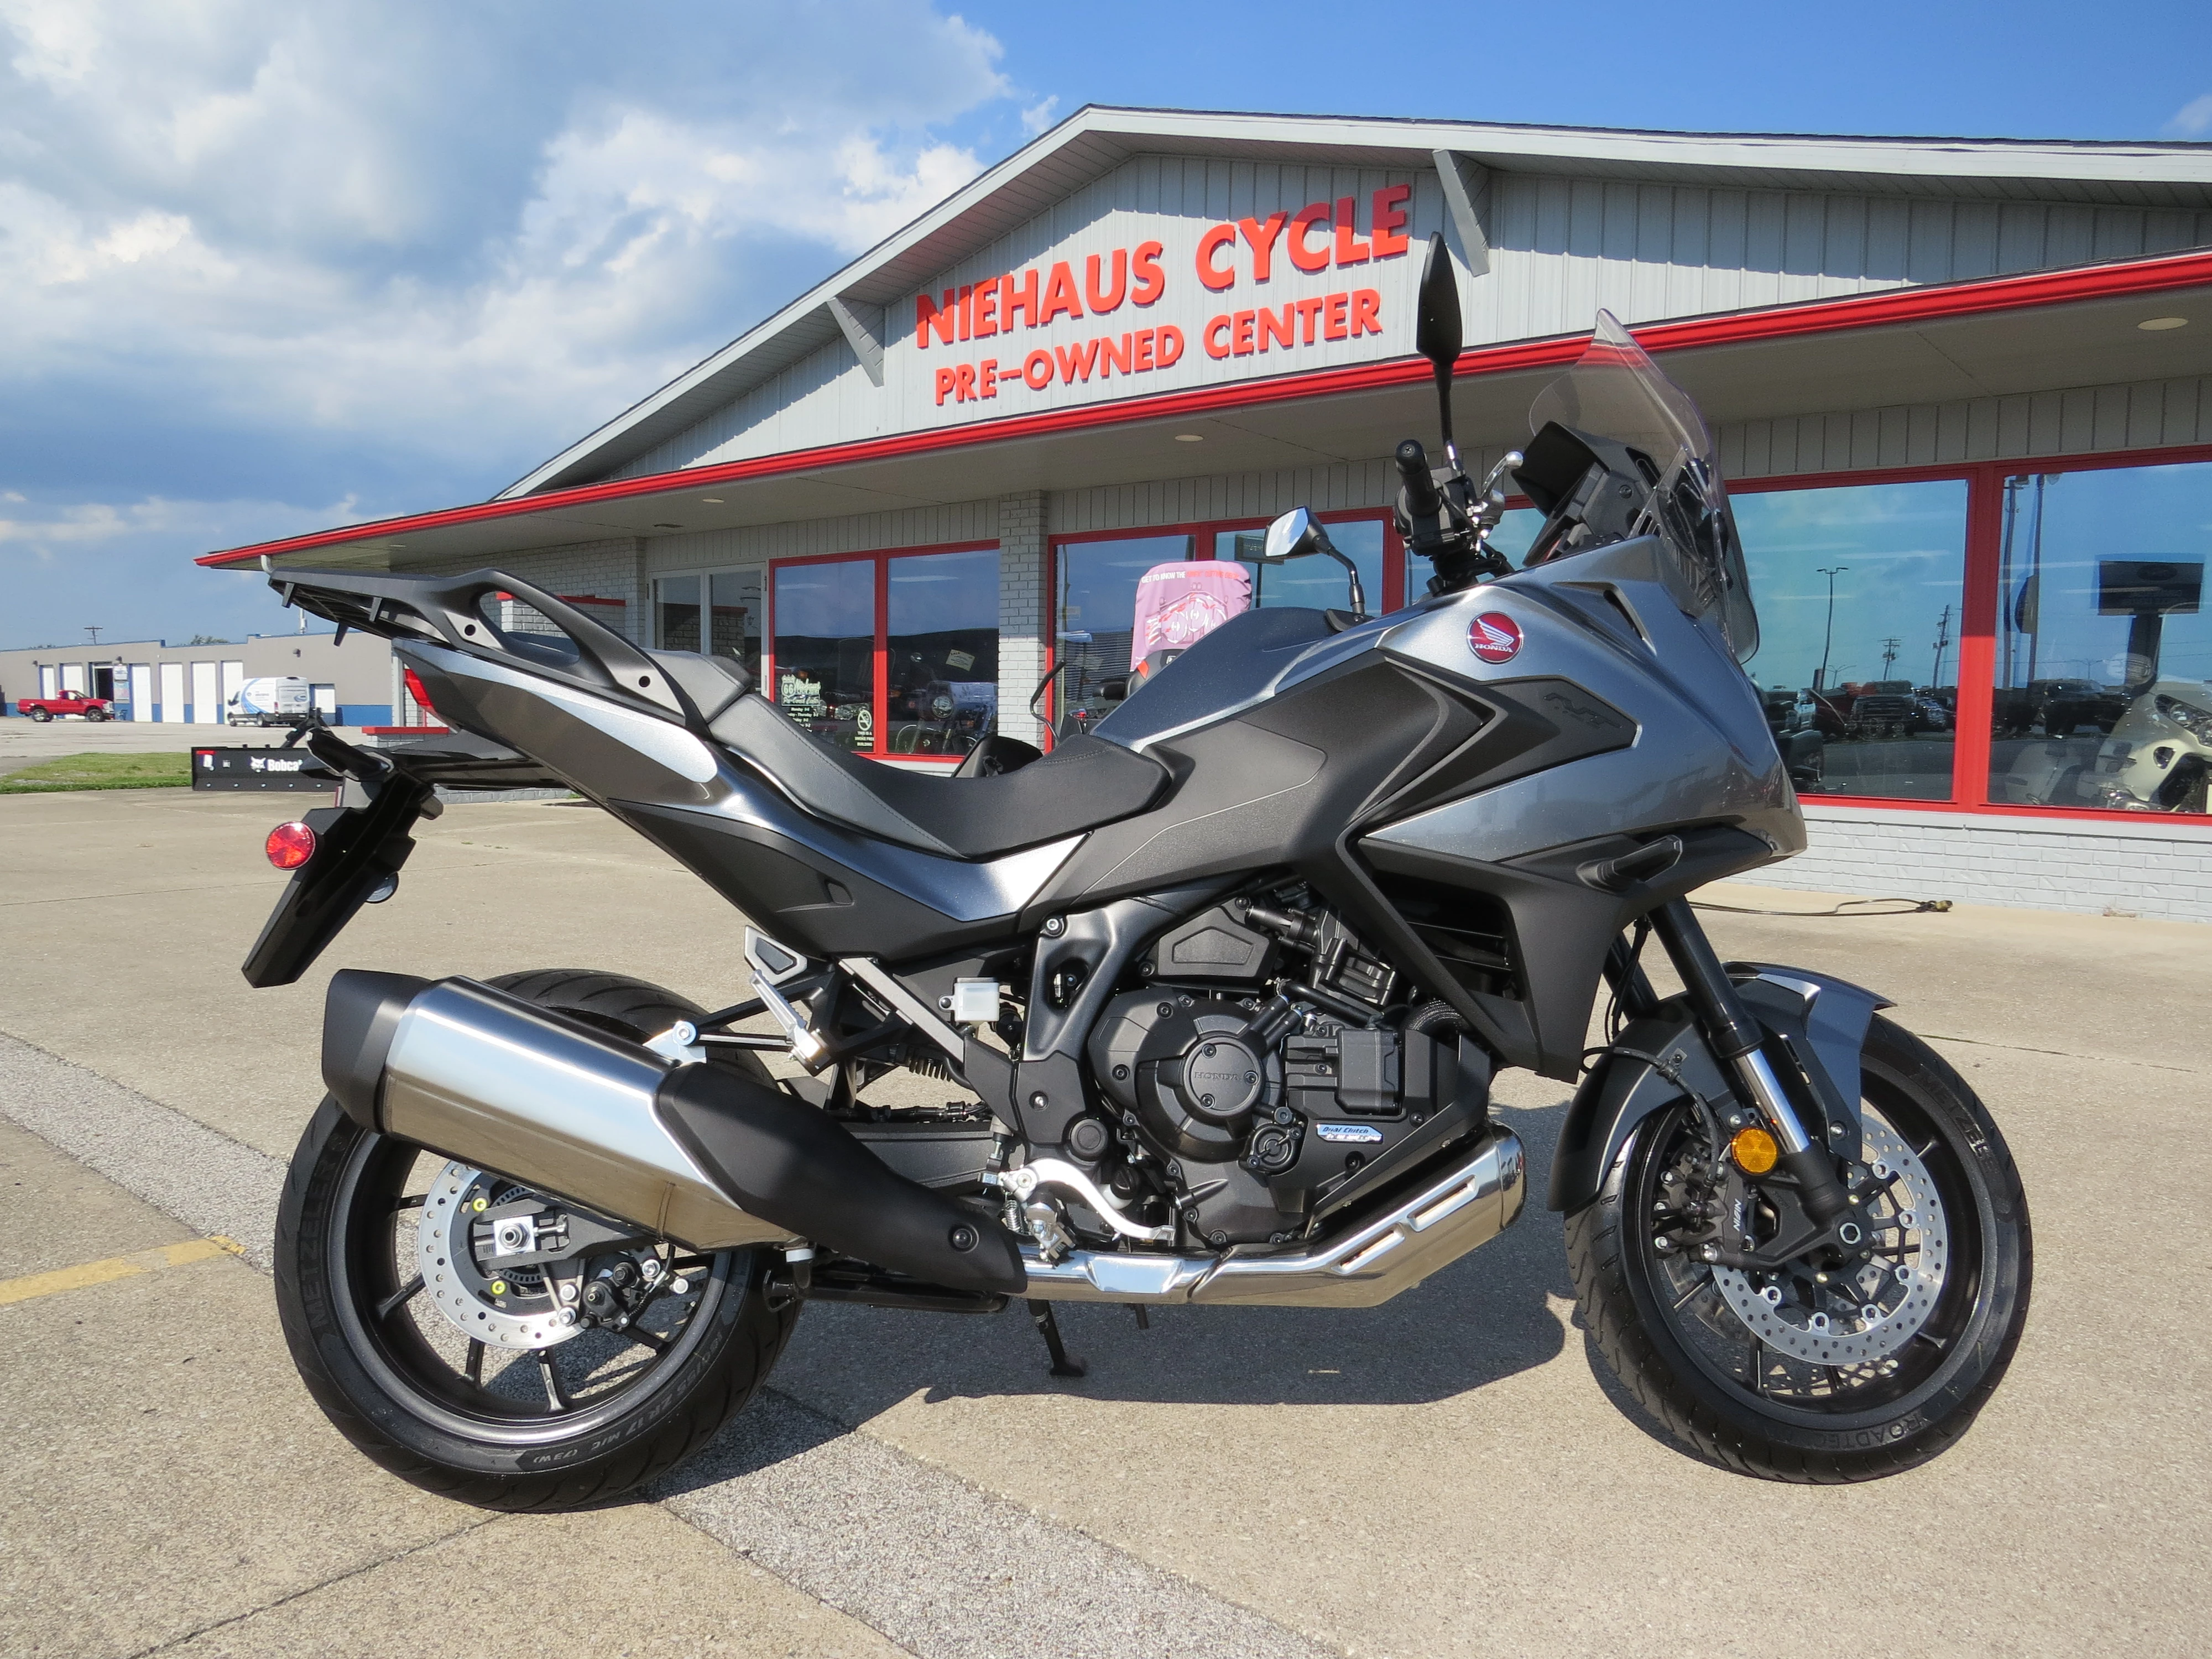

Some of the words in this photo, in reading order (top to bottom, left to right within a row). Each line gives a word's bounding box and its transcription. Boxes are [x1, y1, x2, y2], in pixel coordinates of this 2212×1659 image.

[916, 241, 1165, 348] NIEHAUS
[1196, 184, 1411, 290] CYCLE
[935, 324, 1184, 405] PRE-OWNED
[1203, 288, 1383, 359] CENTER
[1141, 576, 1152, 584] GET
[1160, 571, 1176, 581] KNOW
[1176, 571, 1186, 579] THE
[1474, 643, 1514, 653] HONDA
[784, 684, 794, 695] 66
[1194, 1071, 1239, 1081] HONDA
[300, 1162, 336, 1327] METZELER
